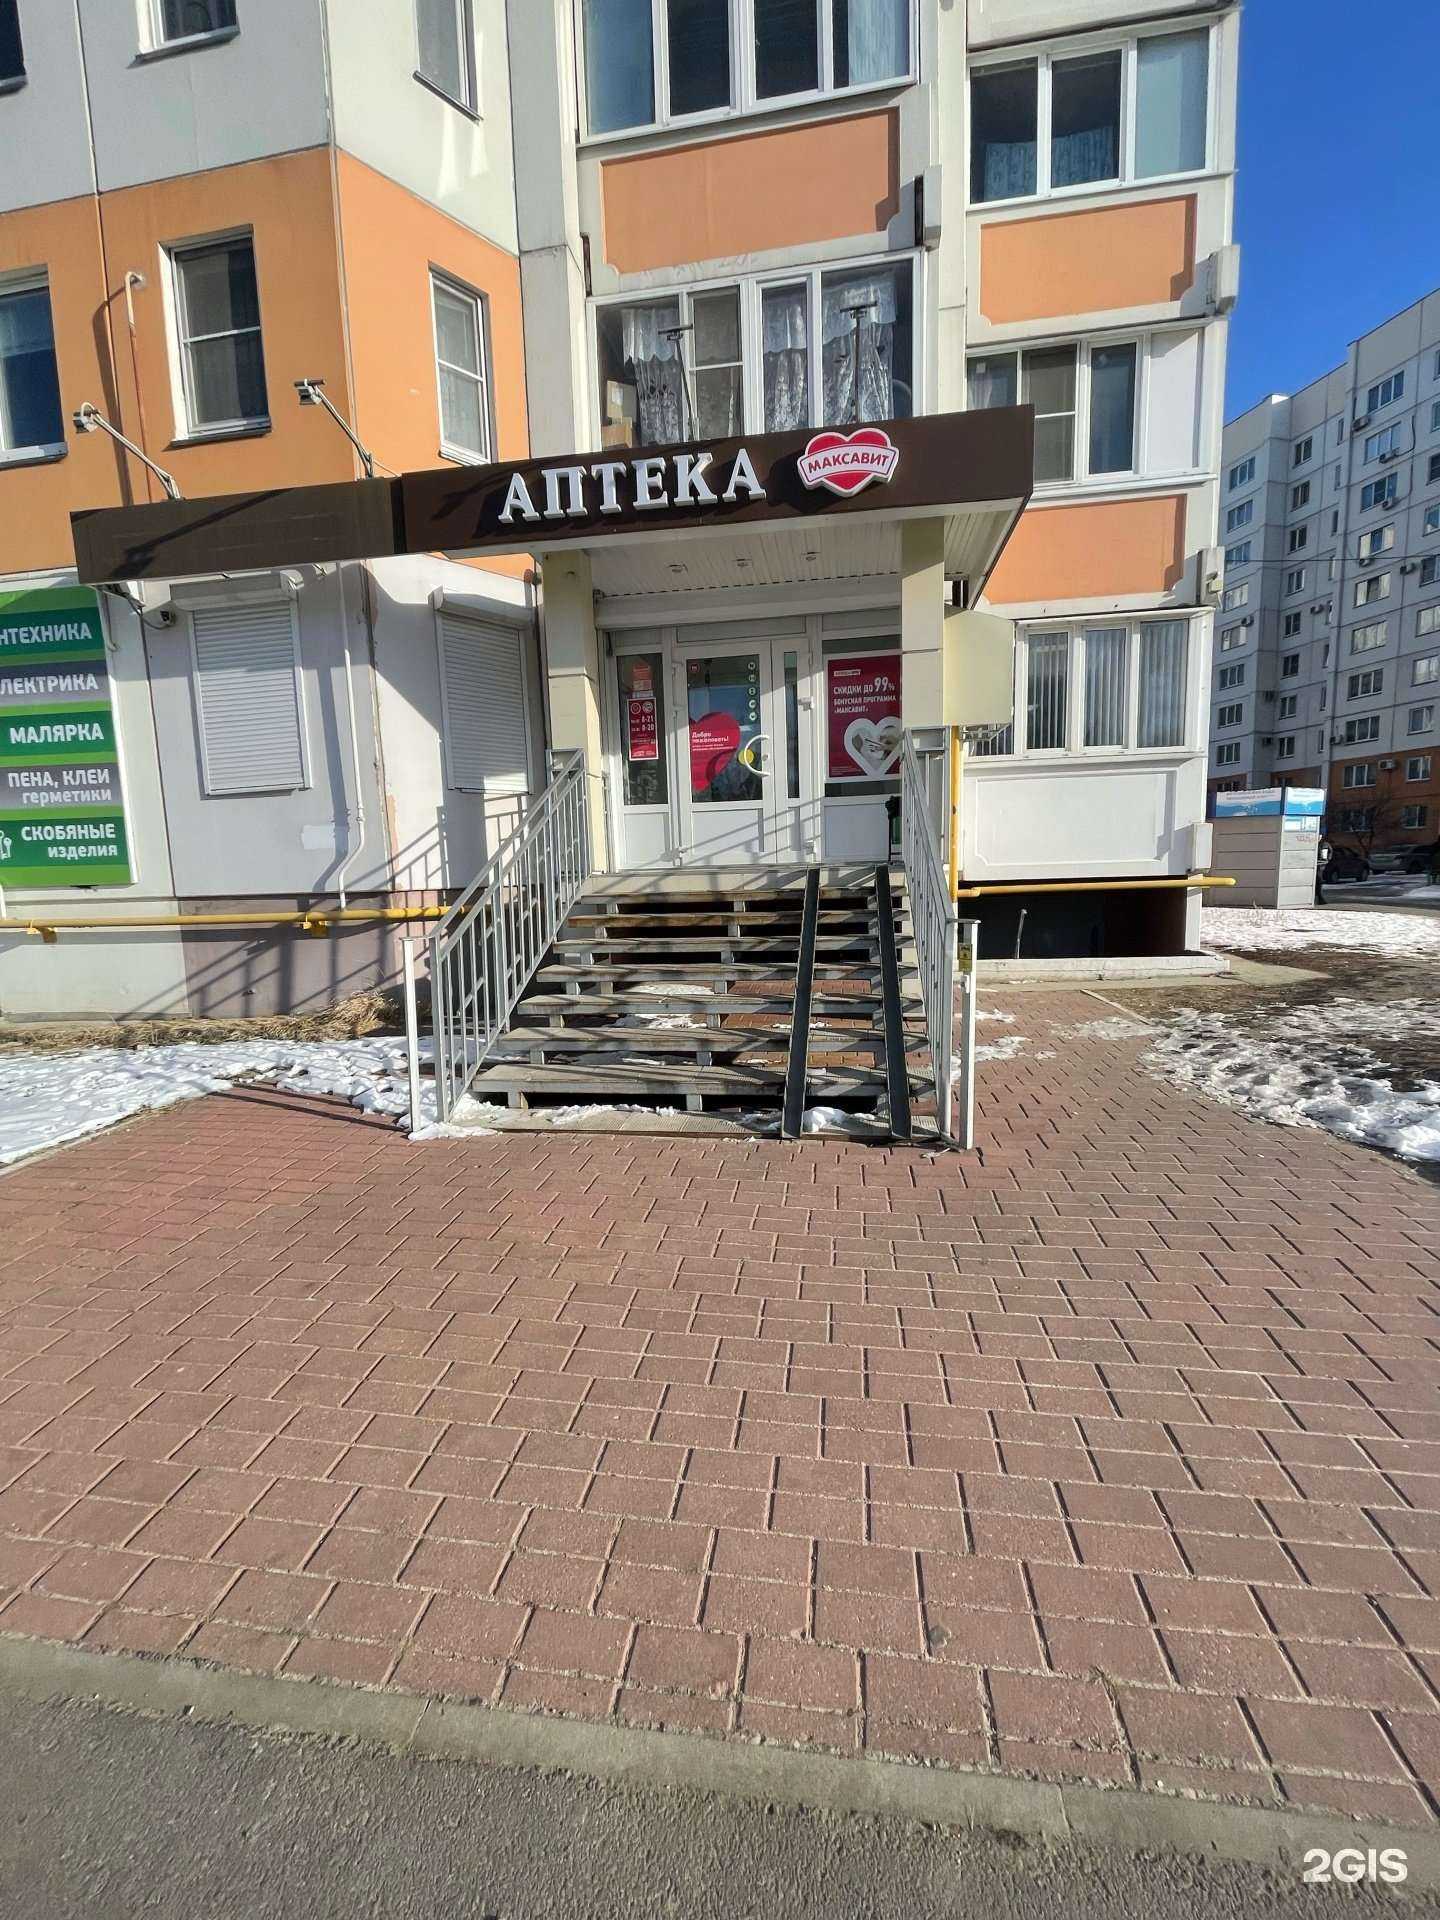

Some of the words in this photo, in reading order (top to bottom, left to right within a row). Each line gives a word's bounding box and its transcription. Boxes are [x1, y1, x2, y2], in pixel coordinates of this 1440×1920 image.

[807, 451, 890, 474] МАКСАВИТ
[498, 448, 767, 523] АПТЕКА
[0, 673, 99, 695] ЛЕКТРИКА
[833, 685, 862, 695] СКИДКИ
[863, 684, 873, 694] ДО
[874, 676, 895, 692] 99%
[10, 723, 104, 744] МАЛЯРКА
[8, 771, 58, 788] ПЕНА,
[62, 768, 110, 786] КЛЕИ
[22, 789, 112, 807] герметики
[21, 823, 116, 841] СКОБЯНЫЕ
[48, 844, 118, 860] изделия
